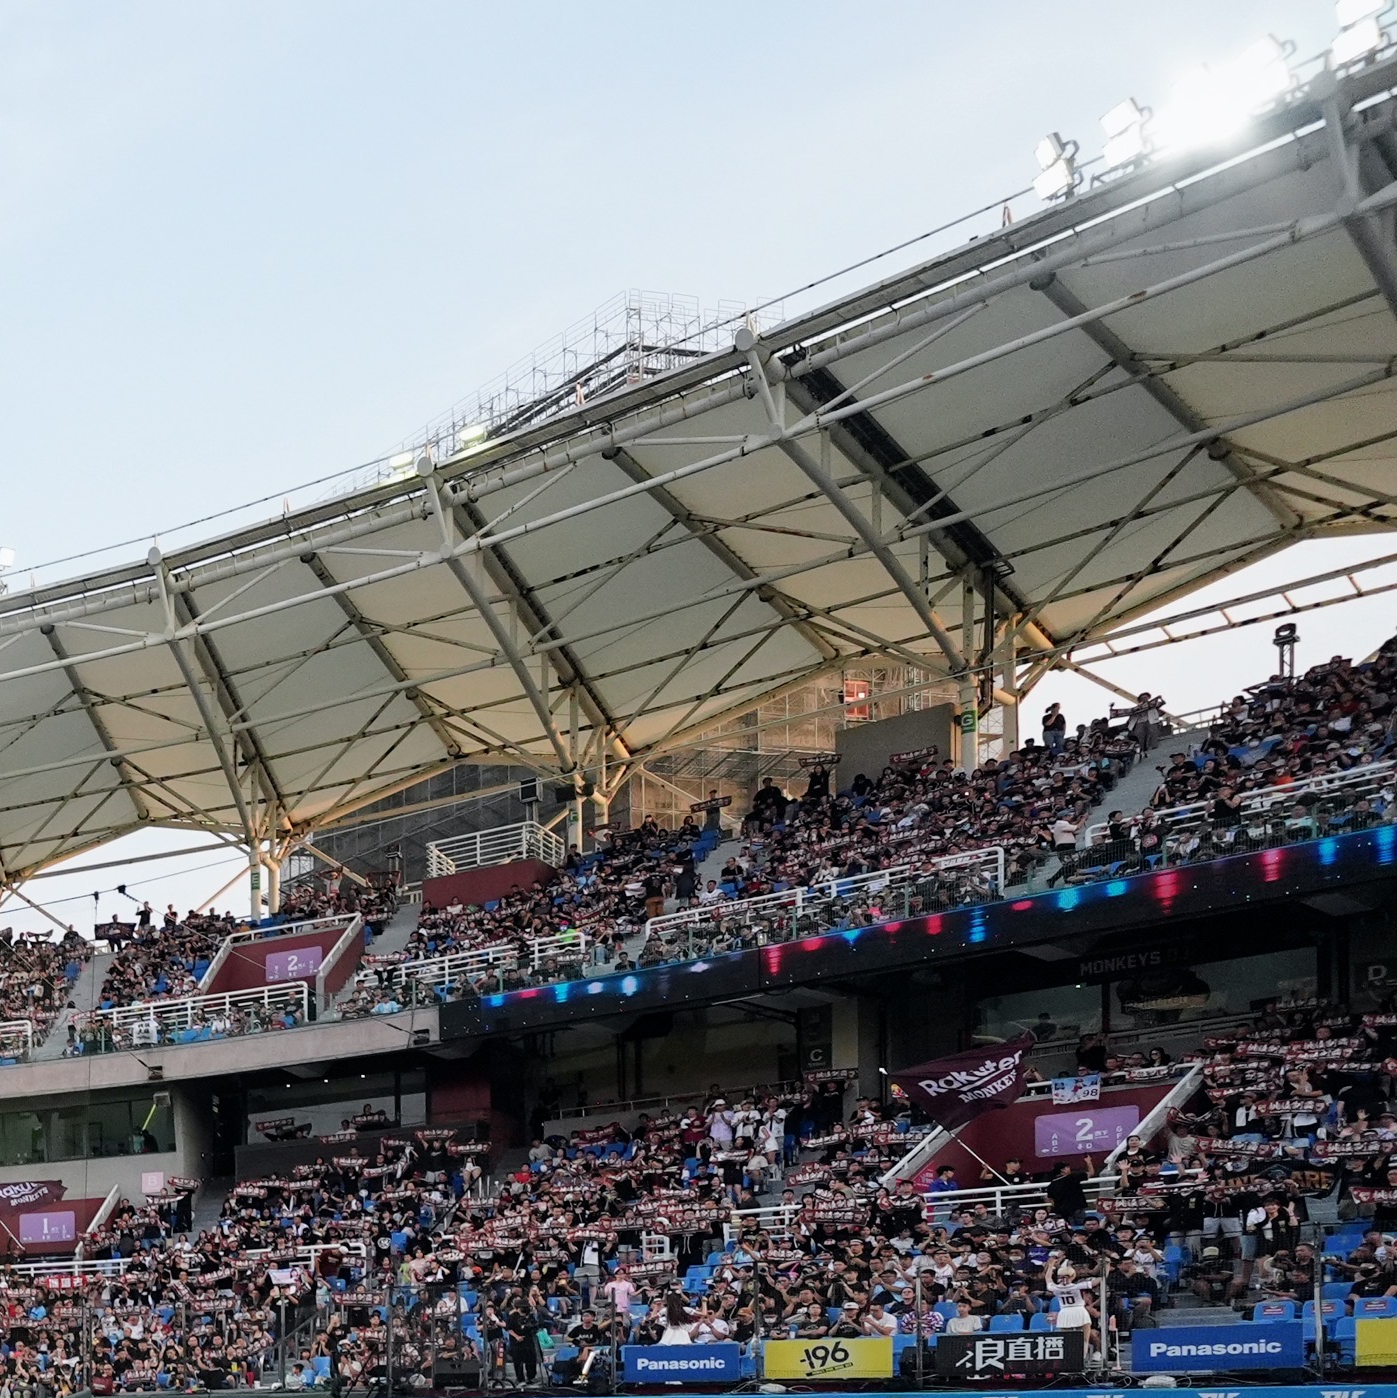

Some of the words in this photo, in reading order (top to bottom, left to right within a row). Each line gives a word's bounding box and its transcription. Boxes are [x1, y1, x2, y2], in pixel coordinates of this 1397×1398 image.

[287, 955, 298, 971] 2
[1083, 1089, 1098, 1098] 98
[1075, 1118, 1093, 1141] 2
[43, 1218, 49, 1234] 1
[1062, 1295, 1075, 1305] 10
[956, 1337, 1064, 1370] 浪直播
[1149, 1339, 1282, 1357] Panasonic
[637, 1357, 725, 1370] Panasonic
